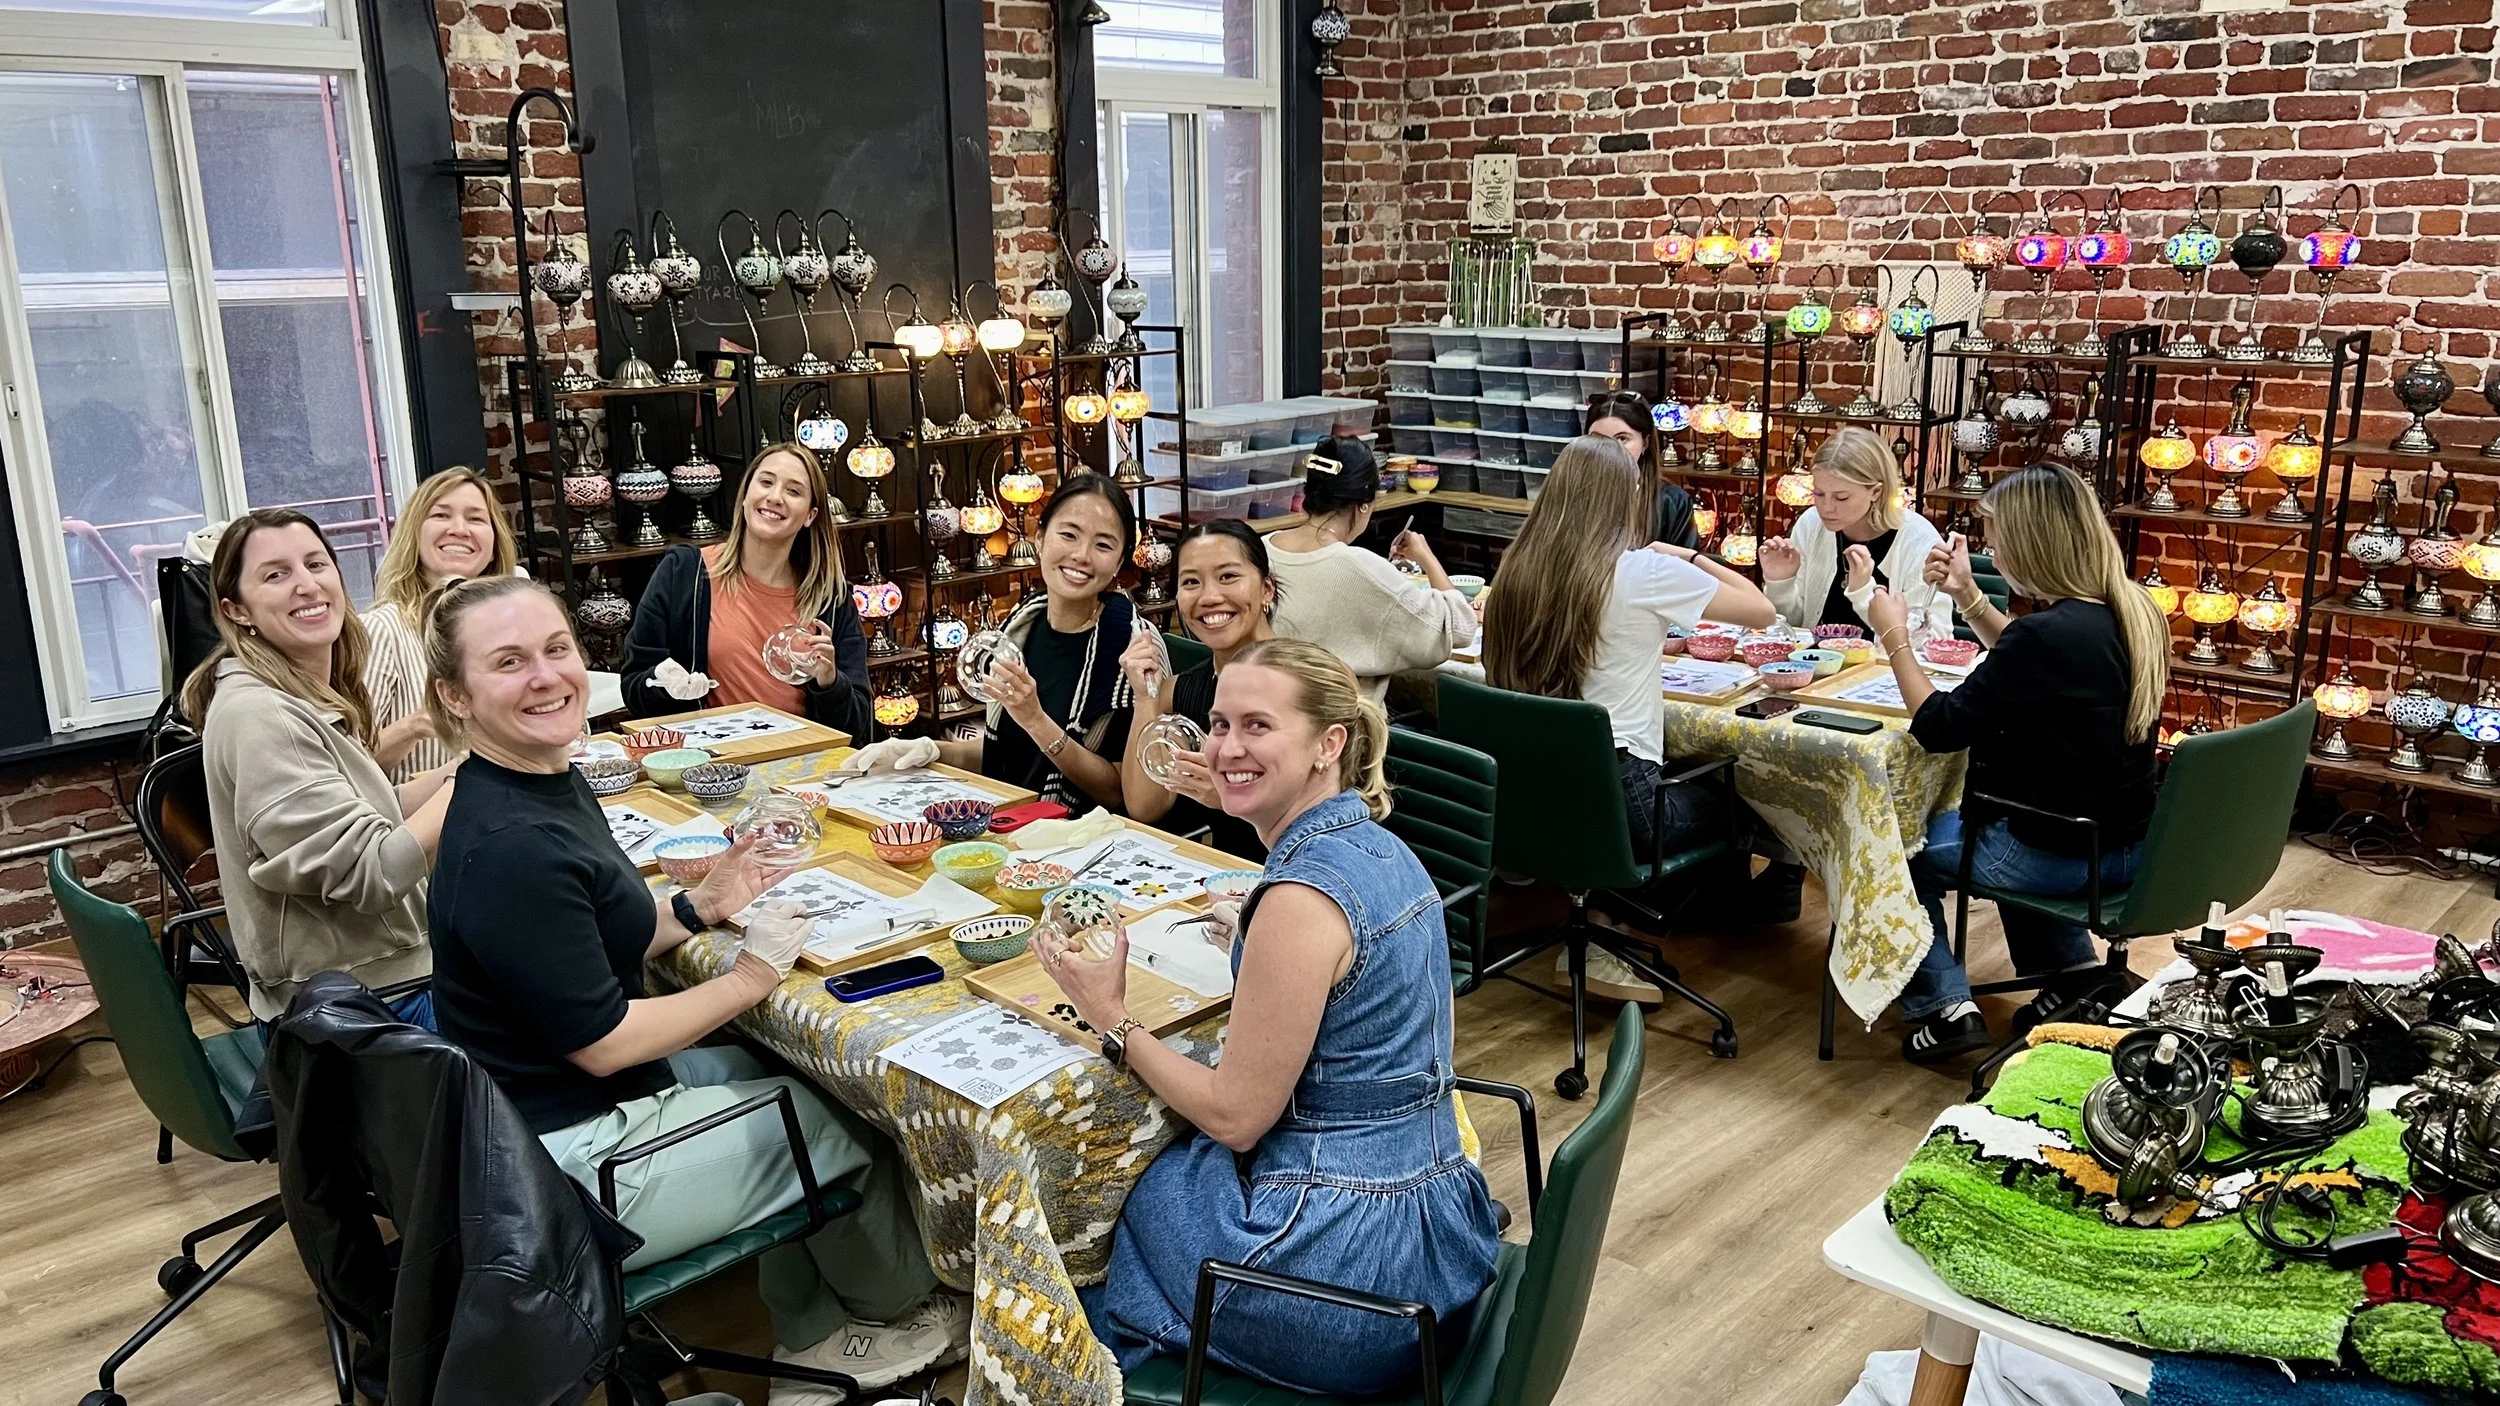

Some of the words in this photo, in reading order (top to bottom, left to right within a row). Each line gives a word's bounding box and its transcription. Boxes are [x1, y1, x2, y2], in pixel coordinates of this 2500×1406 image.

[923, 1023, 960, 1043] DESIGN
[958, 1008, 1003, 1026] TEMPLAT
[843, 1335, 872, 1357] N
